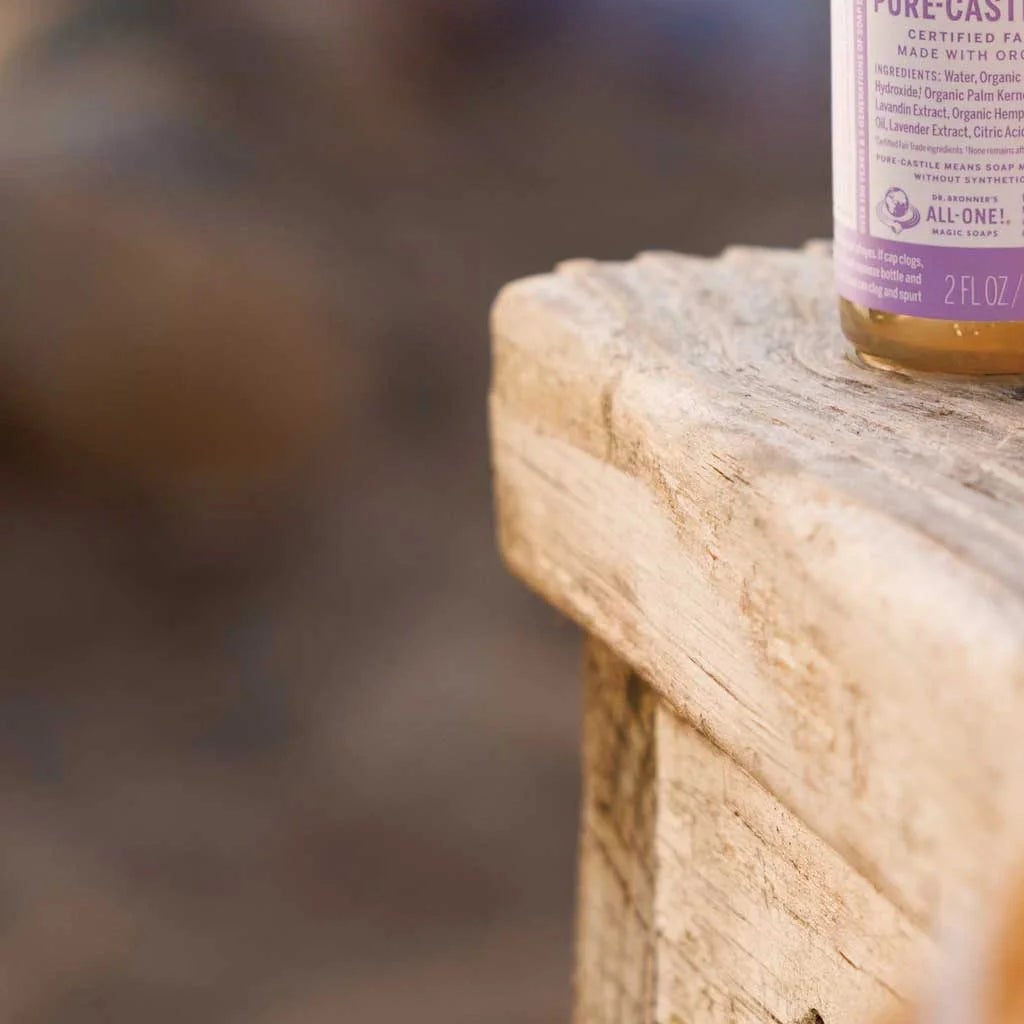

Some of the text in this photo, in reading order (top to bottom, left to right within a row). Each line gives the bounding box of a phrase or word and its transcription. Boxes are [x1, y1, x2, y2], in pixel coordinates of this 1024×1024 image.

[908, 29, 995, 43] CERTIFIED
[898, 44, 939, 59] MADE
[946, 49, 988, 61] WITH
[875, 63, 942, 82] INGREDIENTS:
[944, 69, 978, 85] Water,
[980, 70, 1021, 86] Organic
[925, 86, 964, 102] Organic
[967, 88, 994, 102] Palm
[875, 98, 911, 115] Lavandin
[913, 104, 950, 119] Extract,
[952, 107, 992, 122] Organic
[994, 108, 1024, 123] Hemp
[889, 119, 929, 135] Lavender
[932, 124, 972, 139] Extract,
[973, 125, 1003, 138] Citric
[876, 154, 940, 170] PURE-CASTILE
[944, 162, 981, 171] MEANS
[985, 163, 1014, 171] SOAP
[914, 173, 960, 184] WITHOUT
[932, 228, 998, 237] MAGIC SOAPS
[905, 273, 922, 285] and
[899, 289, 922, 303] spurt
[944, 275, 955, 304] 2
[962, 275, 981, 305] FL
